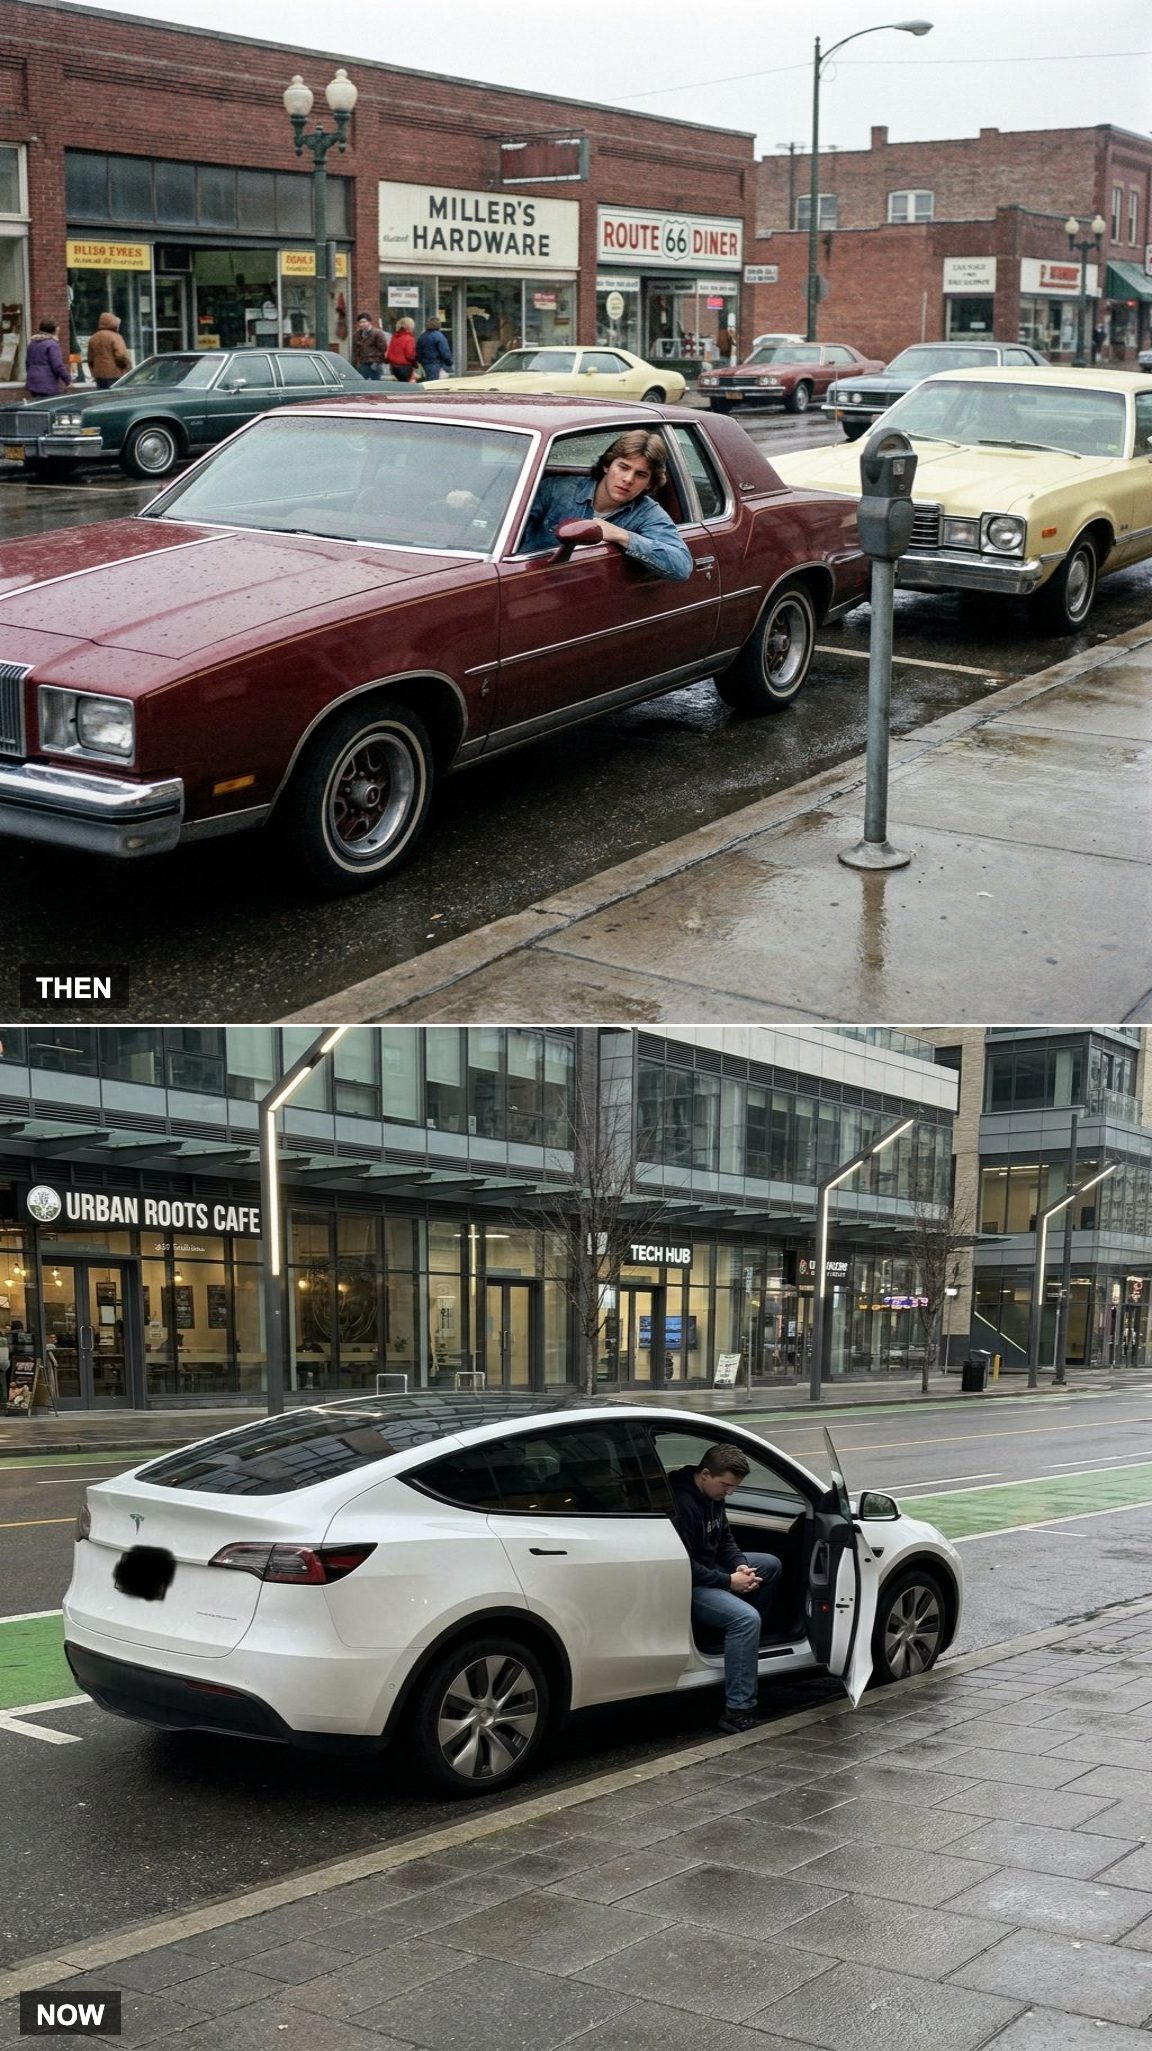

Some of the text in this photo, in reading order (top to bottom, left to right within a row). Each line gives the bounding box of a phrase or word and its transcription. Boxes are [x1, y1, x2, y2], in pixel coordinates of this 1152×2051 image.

[429, 195, 535, 226] MILLER'S
[413, 224, 550, 257] HARDWARE
[603, 221, 738, 256] ROUTE 66 DINER
[66, 1192, 261, 1233] URBAN ROOTS CAFE
[630, 1244, 691, 1264] TECH HUB
